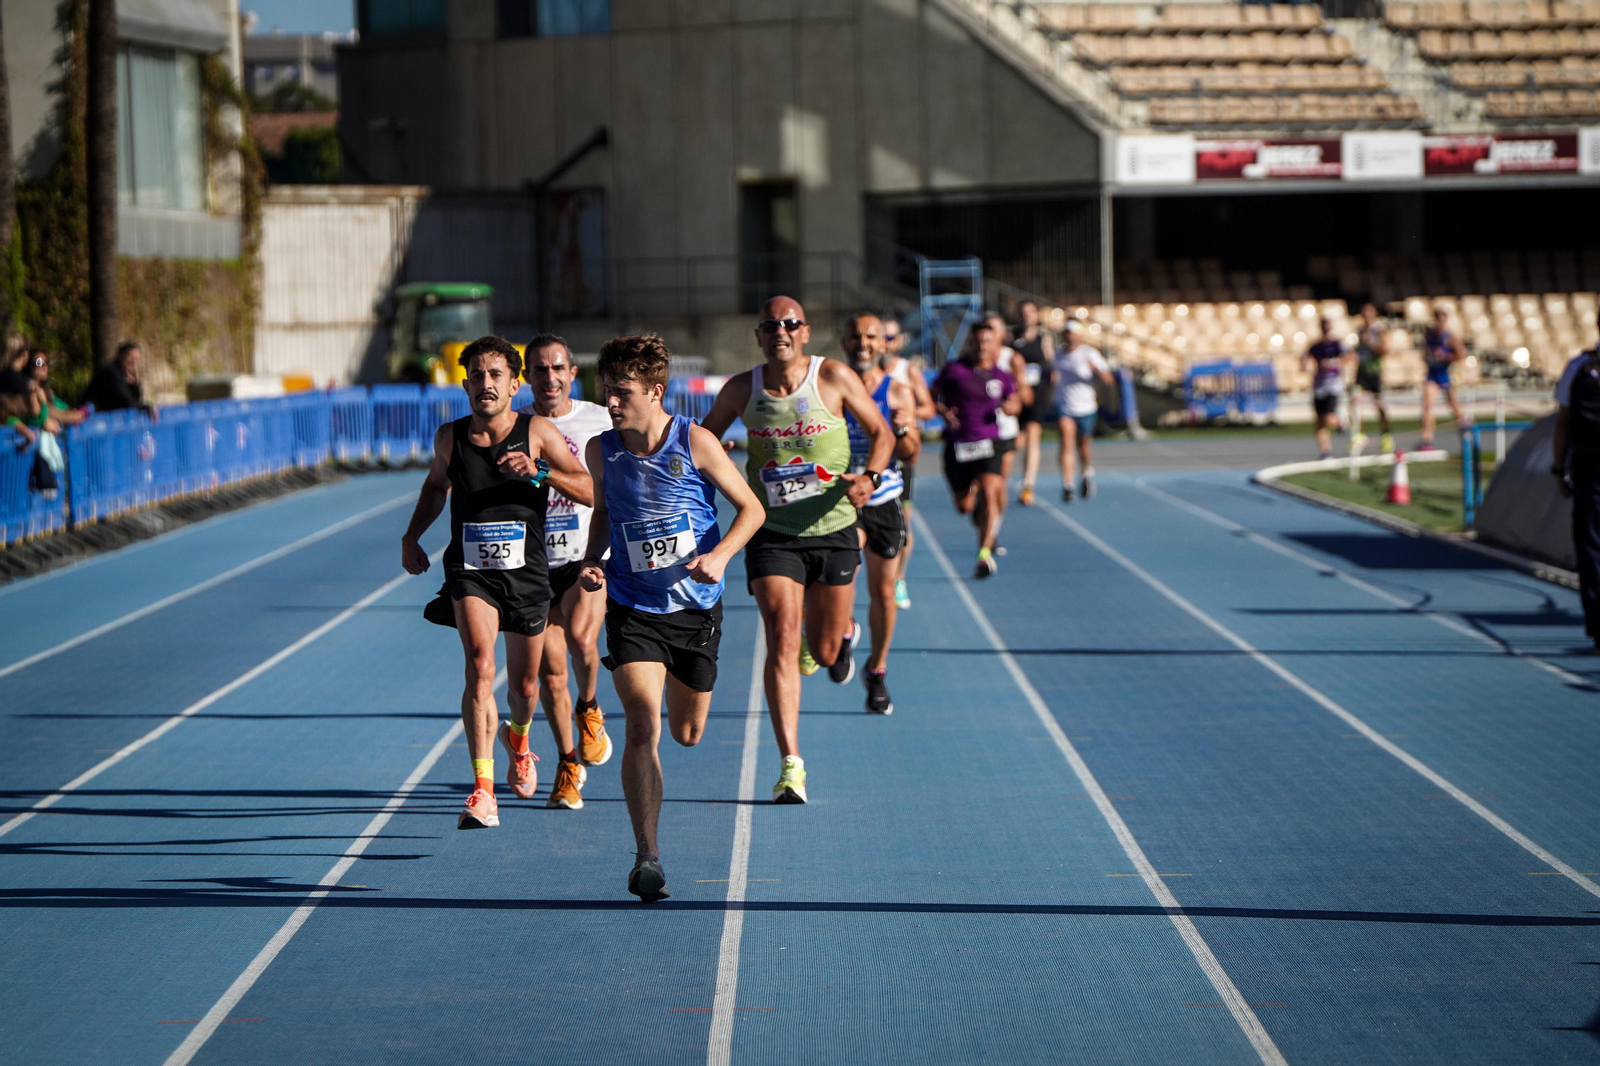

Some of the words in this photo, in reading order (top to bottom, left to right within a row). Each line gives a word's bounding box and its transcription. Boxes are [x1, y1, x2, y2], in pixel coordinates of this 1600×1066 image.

[748, 418, 828, 438] maratón
[764, 439, 814, 450] JEREZ
[776, 477, 807, 497] 225
[662, 516, 682, 524] Popular
[479, 543, 510, 559] 525
[642, 536, 678, 559] 997
